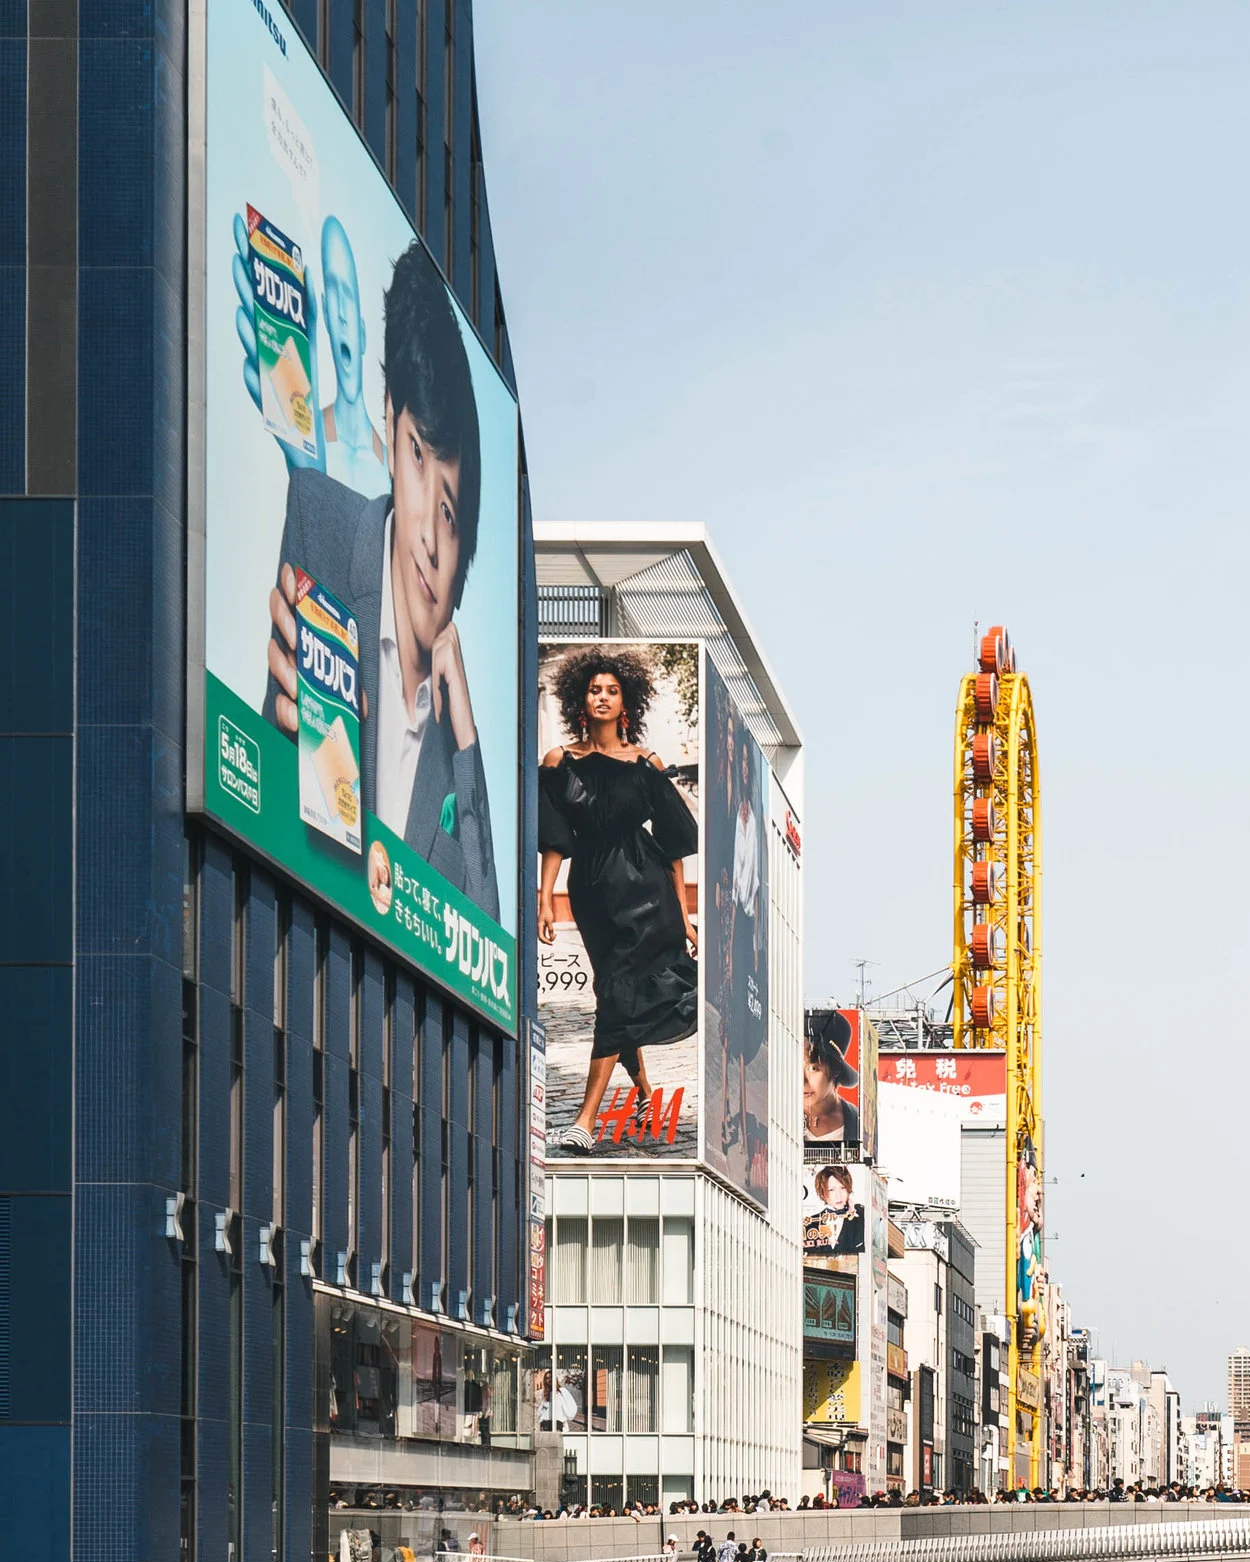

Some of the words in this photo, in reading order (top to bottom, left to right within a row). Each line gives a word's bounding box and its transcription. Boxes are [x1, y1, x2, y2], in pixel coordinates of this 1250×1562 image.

[254, 257, 306, 329] サロンパス
[301, 625, 358, 711] サロンパス
[221, 732, 258, 783] 5月18日は
[221, 765, 258, 807] サロンパスの日
[395, 898, 442, 955] きもちいい。
[443, 902, 511, 1009] サロンパス
[537, 953, 581, 967] ピース
[537, 971, 588, 993] ,999
[895, 1058, 957, 1079] 免税
[597, 1086, 685, 1145] H&M
